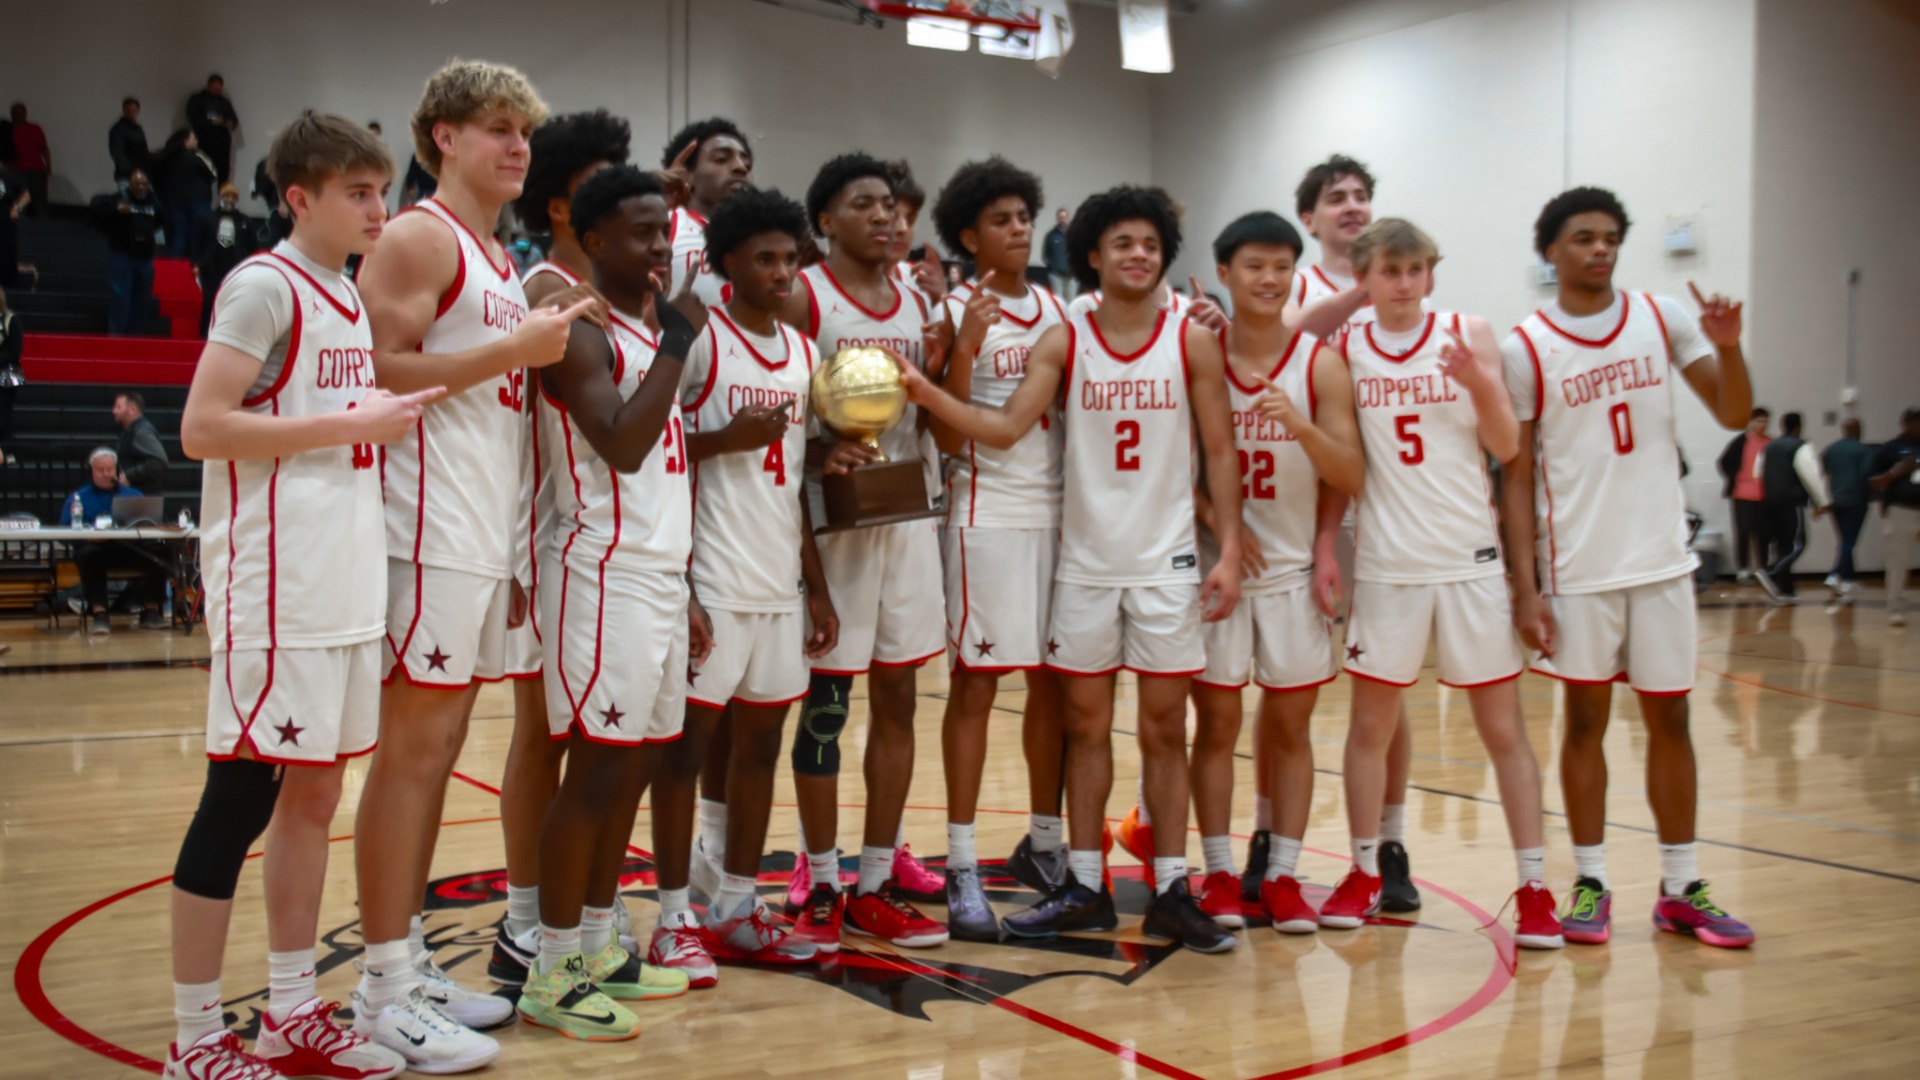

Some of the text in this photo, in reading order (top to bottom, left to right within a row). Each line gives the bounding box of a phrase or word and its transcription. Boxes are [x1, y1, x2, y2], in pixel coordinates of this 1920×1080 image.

[1081, 379, 1178, 411] COPPELL
[1356, 373, 1458, 408] COPPELL
[1562, 355, 1662, 408] COPPELL
[1115, 420, 1141, 471] 2
[1393, 414, 1424, 466] 5
[1607, 401, 1635, 457] 0
[763, 439, 786, 486] 4
